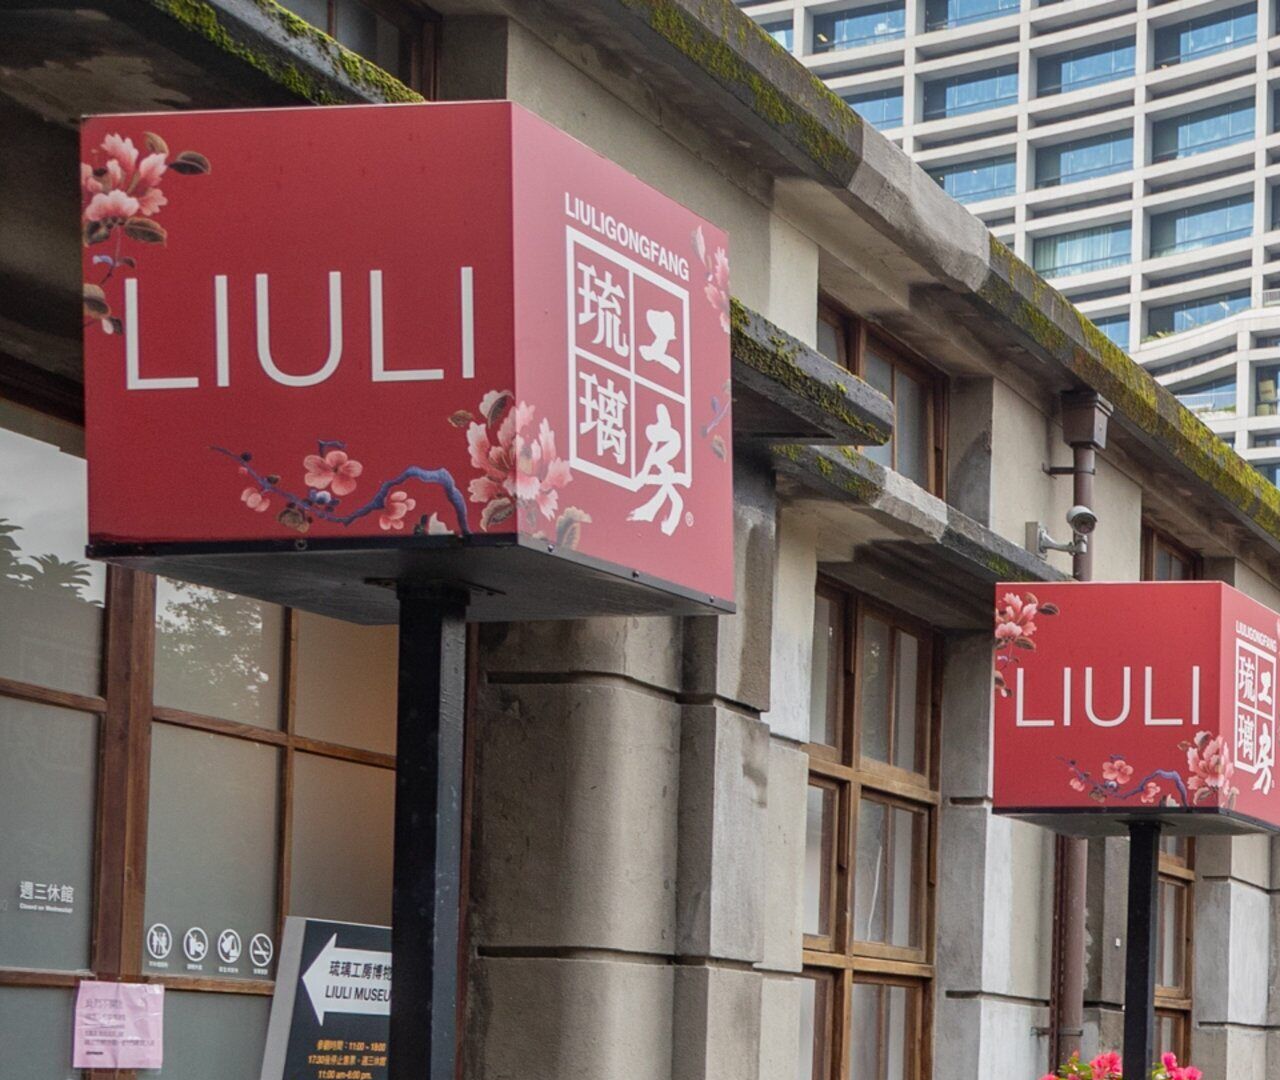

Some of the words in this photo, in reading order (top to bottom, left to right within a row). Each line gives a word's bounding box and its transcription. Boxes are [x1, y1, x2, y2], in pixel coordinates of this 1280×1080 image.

[564, 191, 690, 282] LIULIGONGFANG
[124, 266, 476, 390] LIULI
[1016, 665, 1201, 727] LIULI
[19, 880, 74, 904] 週三休館
[326, 986, 352, 998] LIULI
